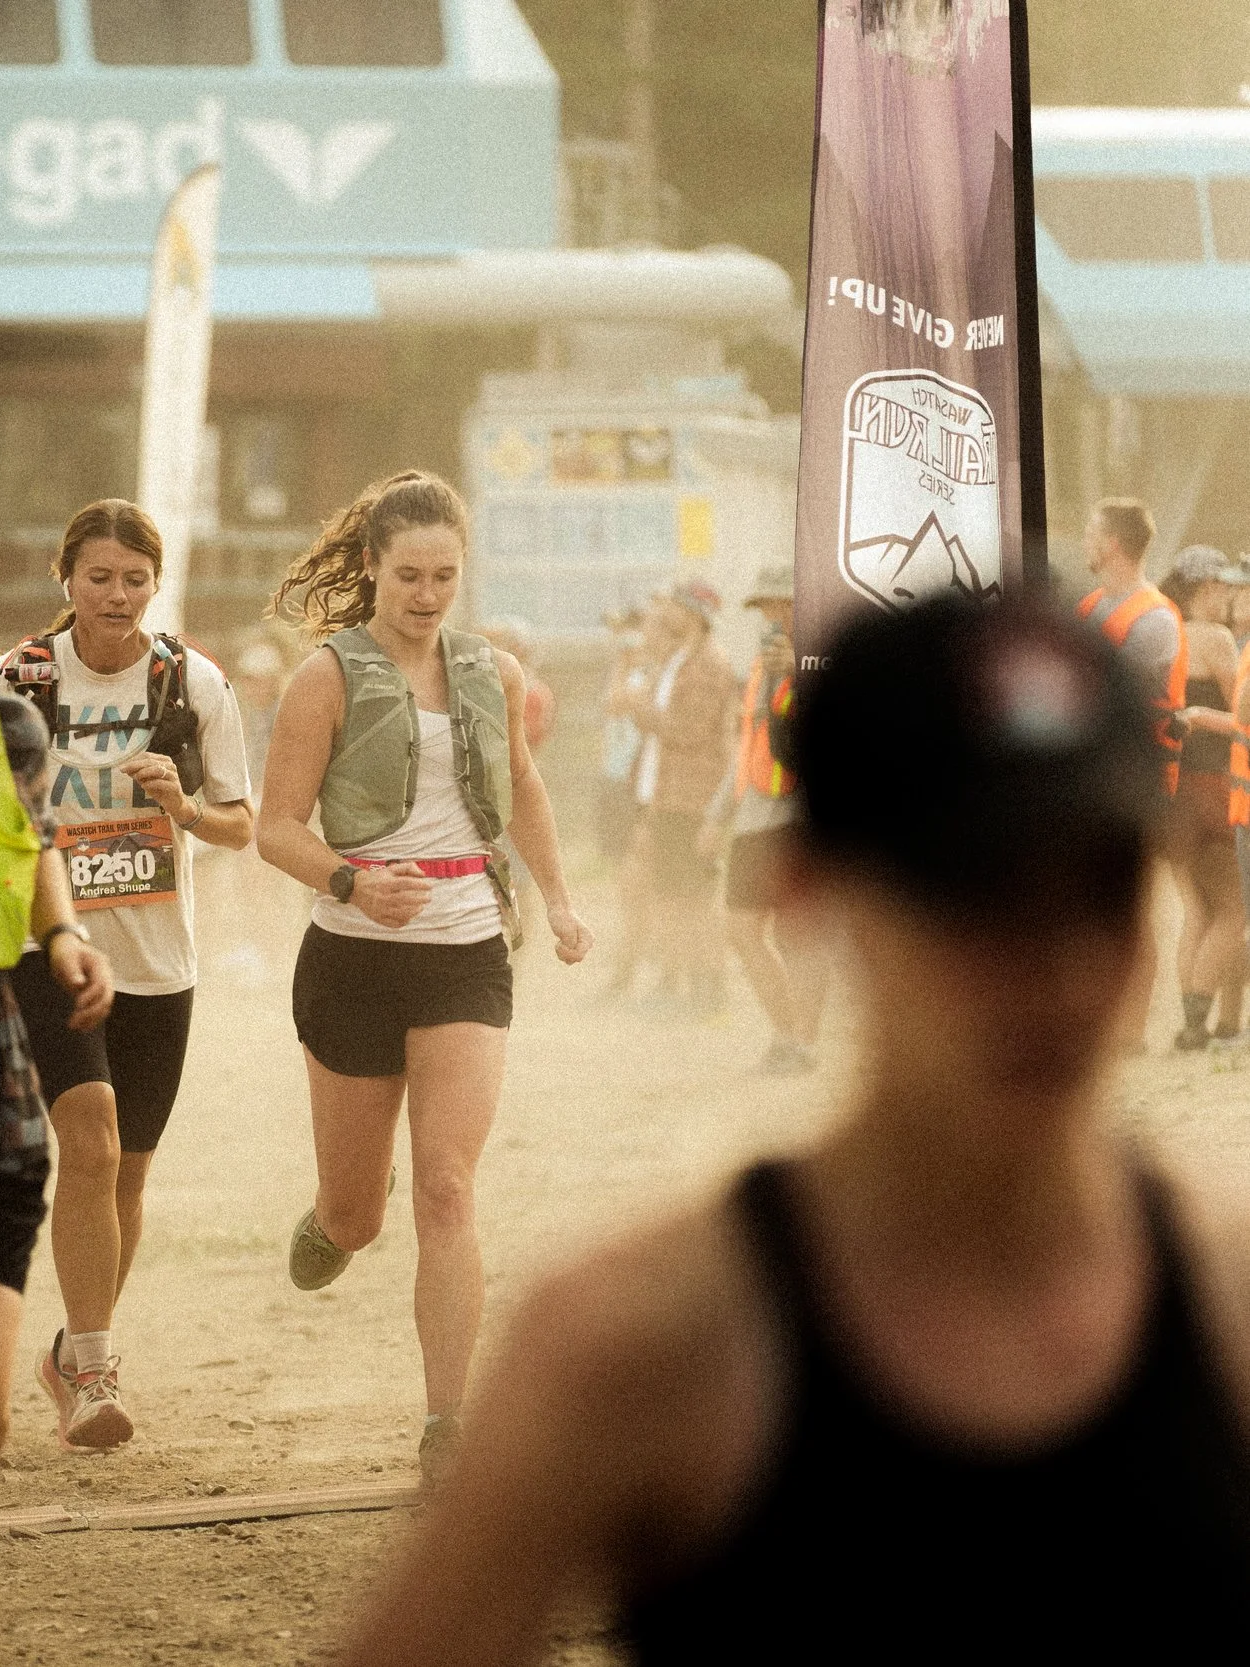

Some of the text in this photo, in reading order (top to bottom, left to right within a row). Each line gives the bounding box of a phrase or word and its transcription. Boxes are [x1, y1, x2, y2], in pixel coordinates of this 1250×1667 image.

[66, 820, 153, 836] WASATCH TRAIL RUN SERIES
[71, 849, 156, 886] 8250
[79, 883, 151, 897] Andrea Shupe
